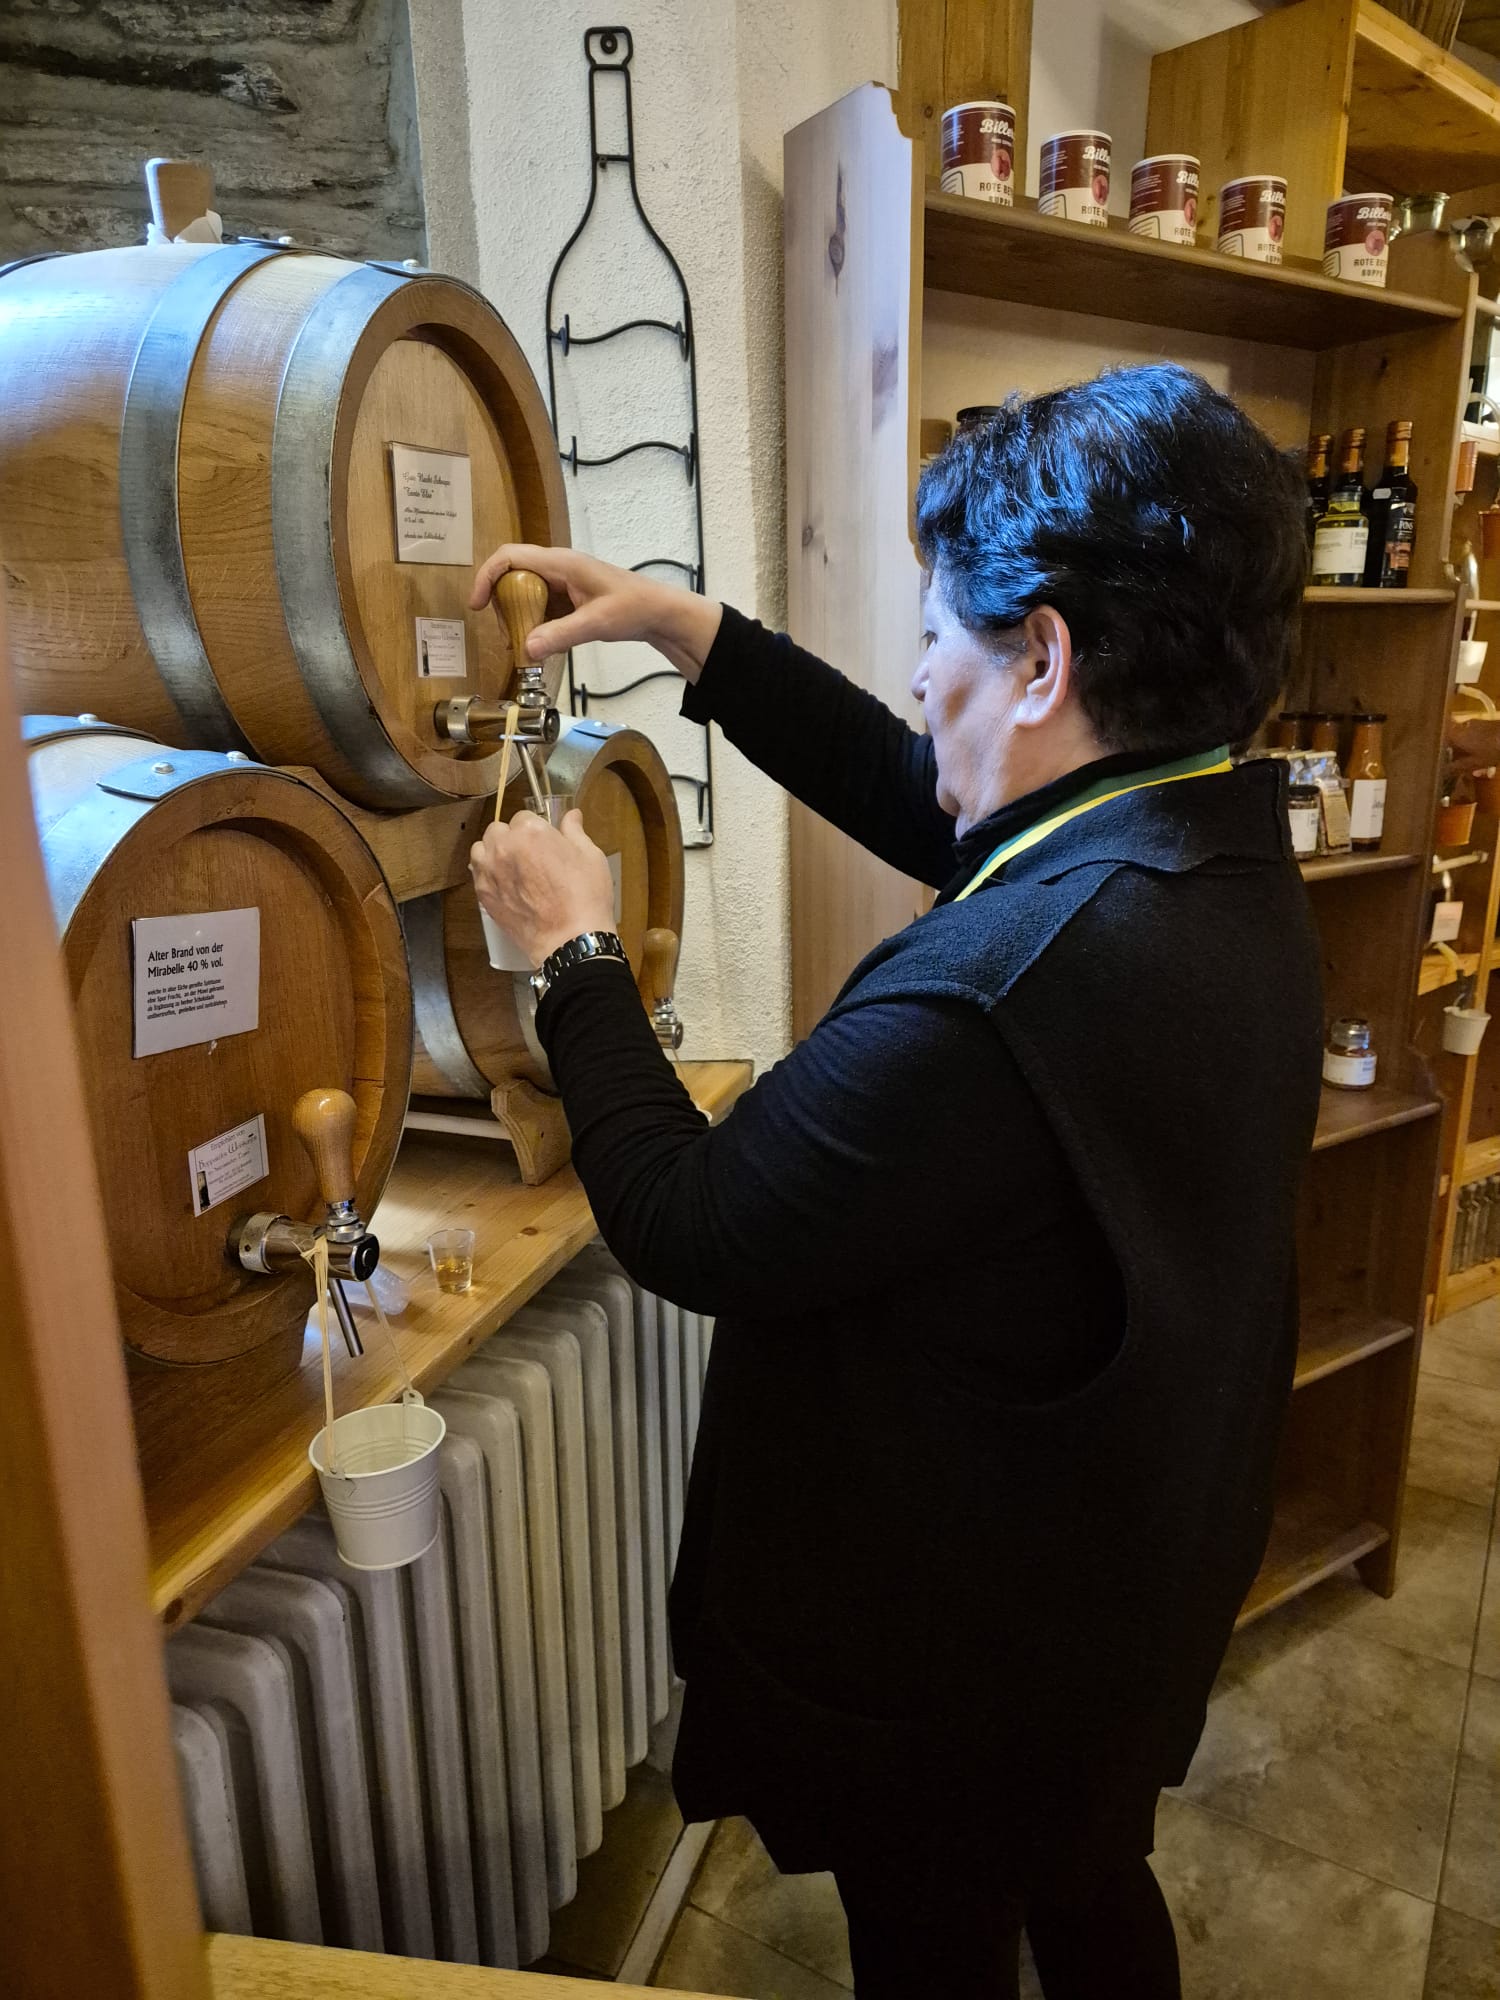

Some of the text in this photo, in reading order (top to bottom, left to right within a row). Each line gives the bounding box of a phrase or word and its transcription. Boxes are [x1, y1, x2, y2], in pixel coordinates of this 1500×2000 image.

[979, 182, 1001, 192] ROTE
[148, 942, 224, 962] Alter Brand von der
[148, 957, 223, 978] Mirabelle 40 % vol.
